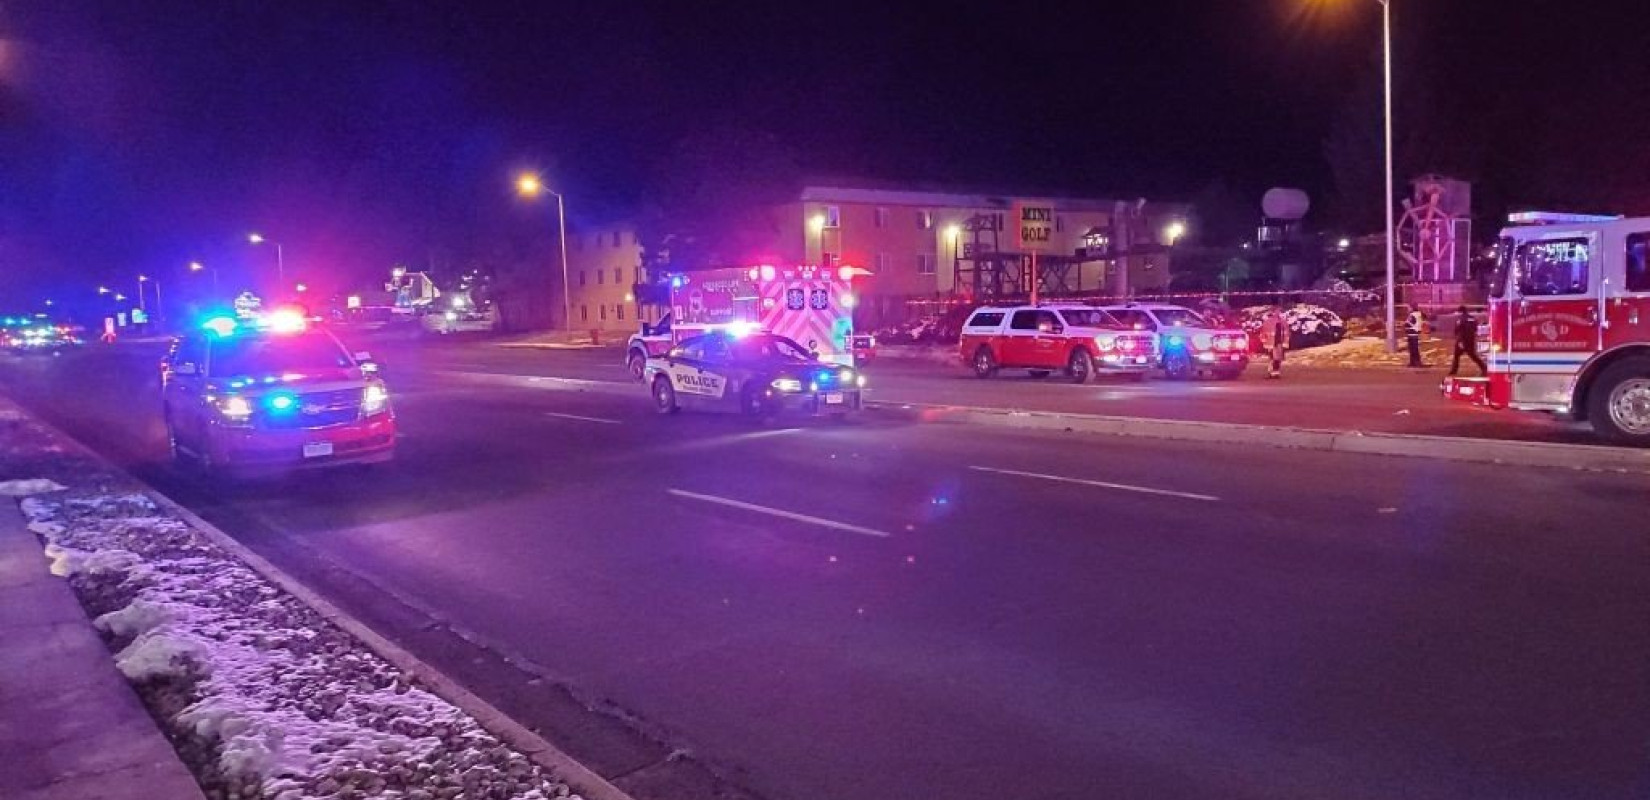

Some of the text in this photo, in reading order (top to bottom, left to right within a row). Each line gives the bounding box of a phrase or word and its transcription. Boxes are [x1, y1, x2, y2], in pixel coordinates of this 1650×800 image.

[1022, 207, 1051, 221] MINI
[1022, 227, 1050, 241] GOLF
[676, 373, 719, 388] POLICE
